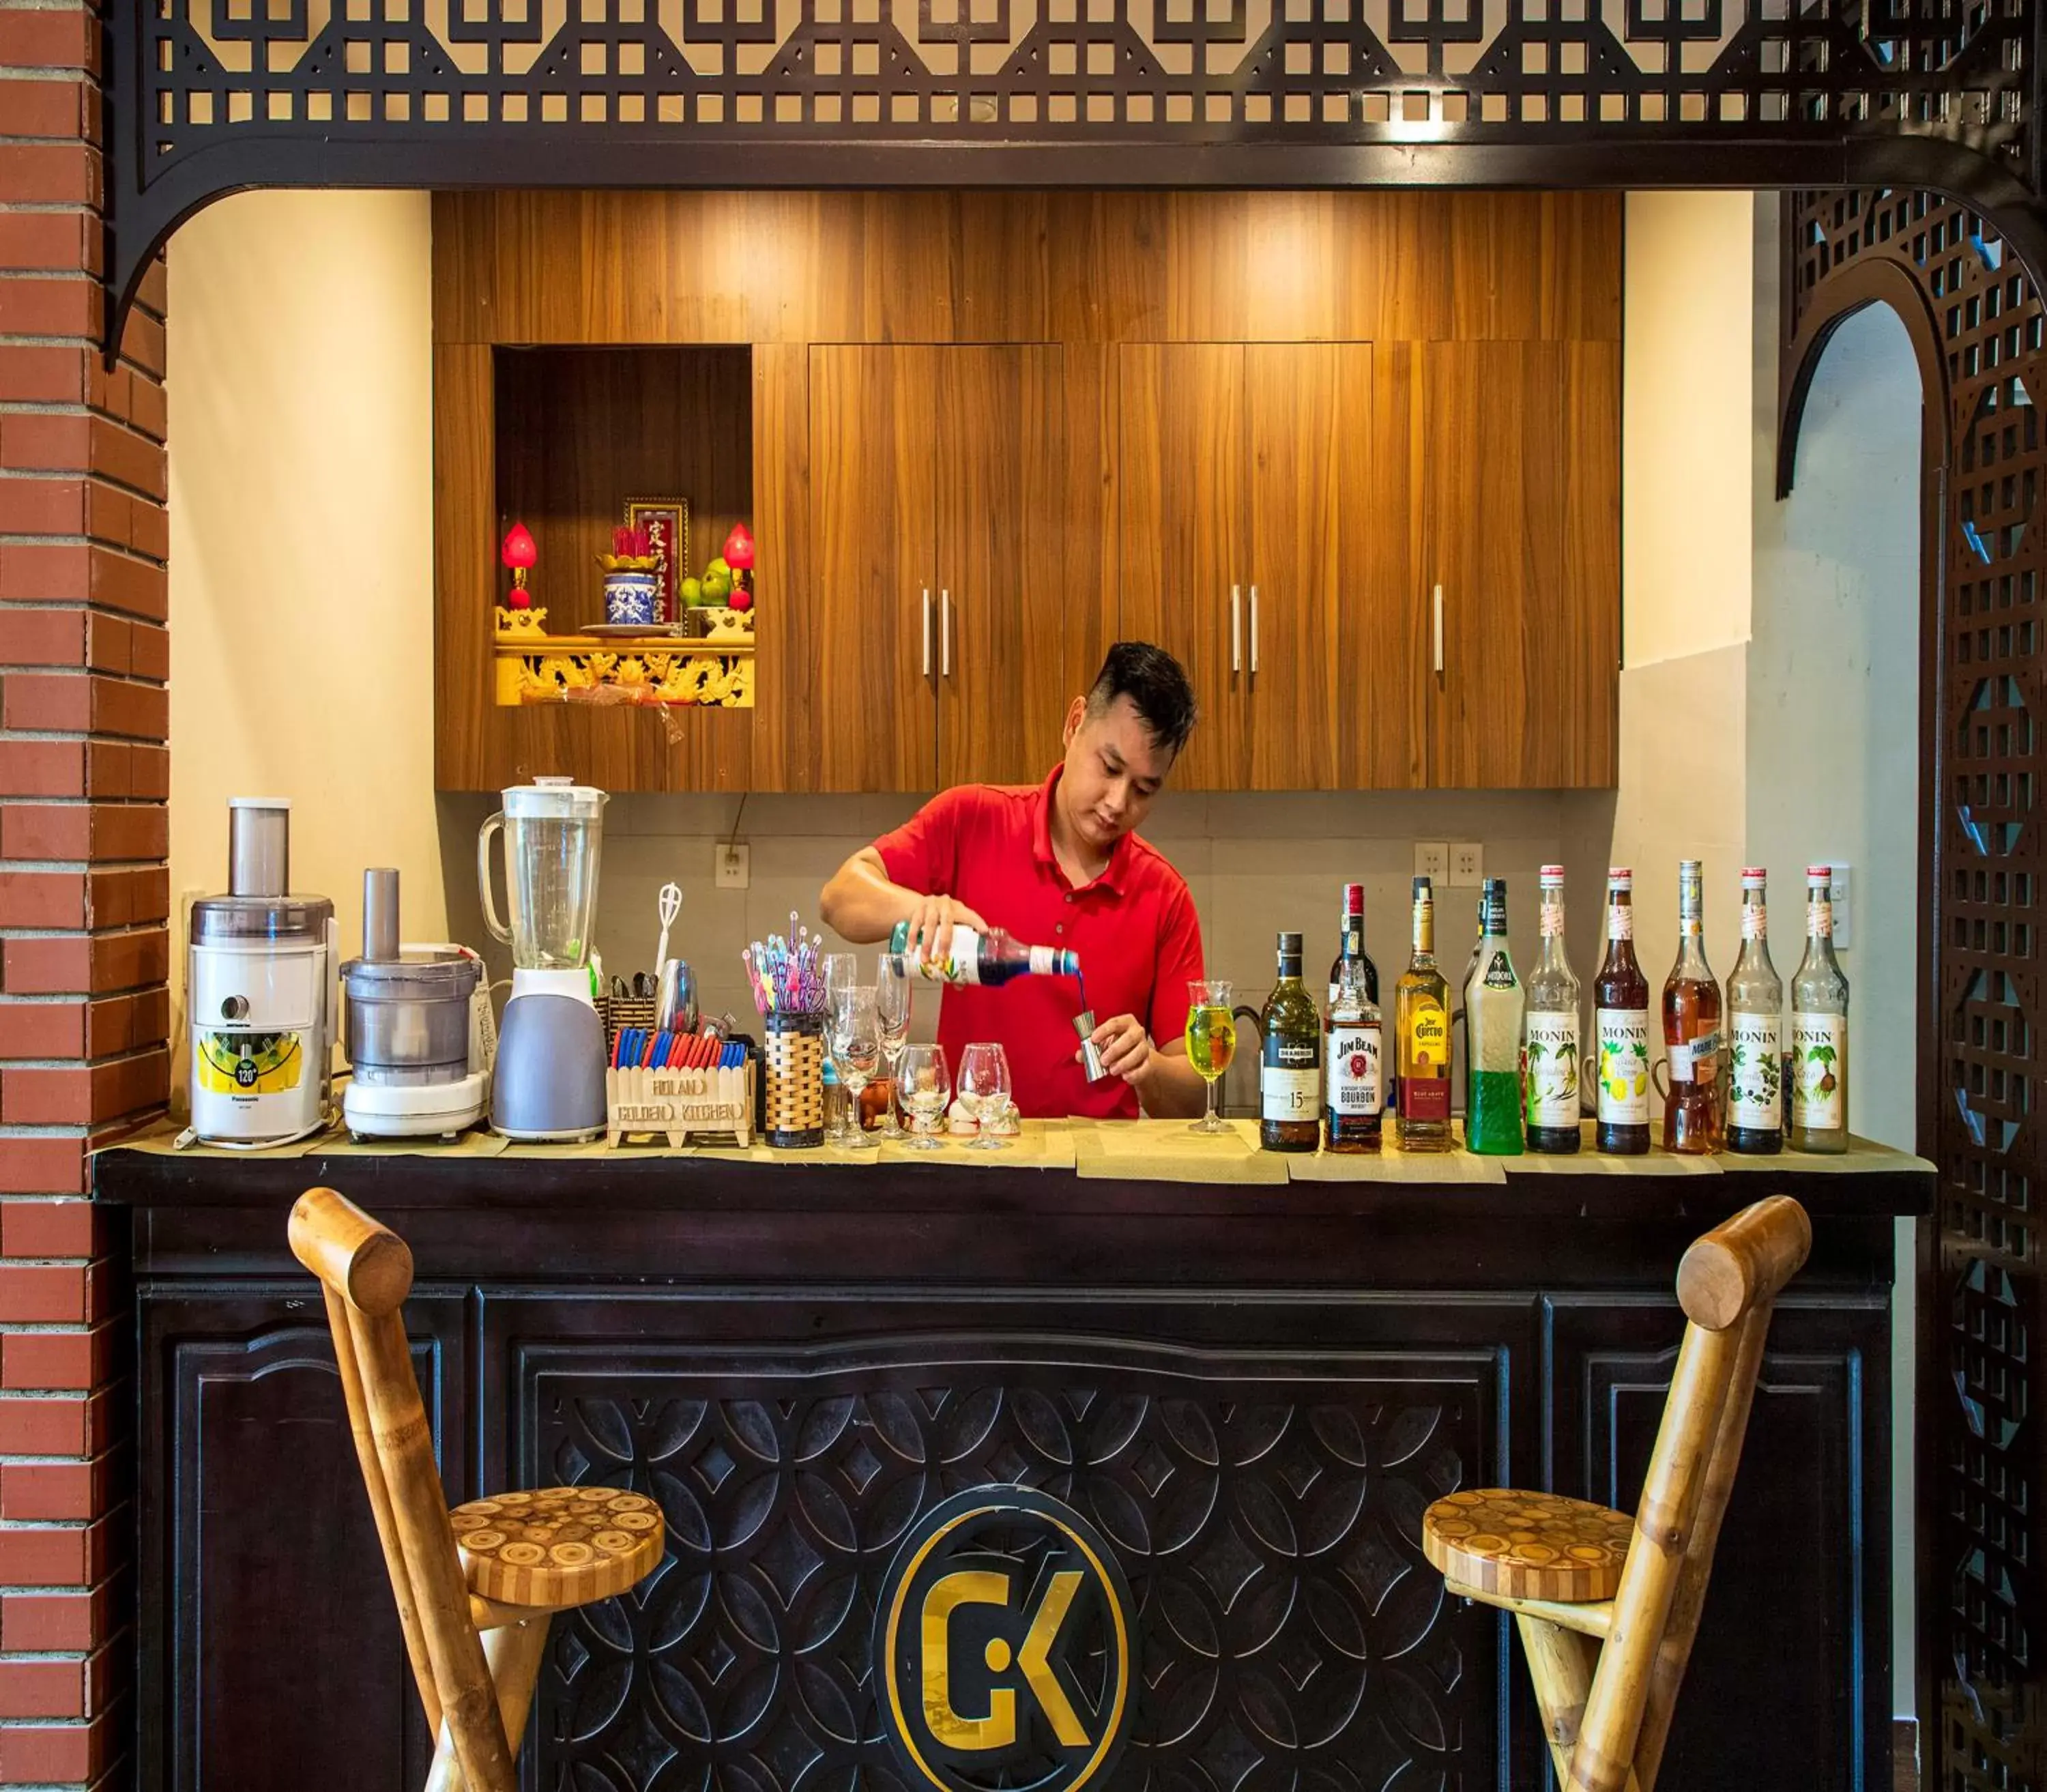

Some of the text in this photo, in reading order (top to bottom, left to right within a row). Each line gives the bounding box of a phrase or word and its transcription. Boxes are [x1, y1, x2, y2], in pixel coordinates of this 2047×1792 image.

[1416, 1024, 1442, 1039] Cuervo
[1530, 1030, 1574, 1041] MONIN
[1603, 1027, 1646, 1038] MONIN
[1731, 1029, 1776, 1043] MONIN
[1792, 1029, 1831, 1042] ONIN
[1337, 1037, 1378, 1059] JIM BEAM
[1290, 1092, 1303, 1109] 15
[1341, 1092, 1375, 1103] BOURBON
